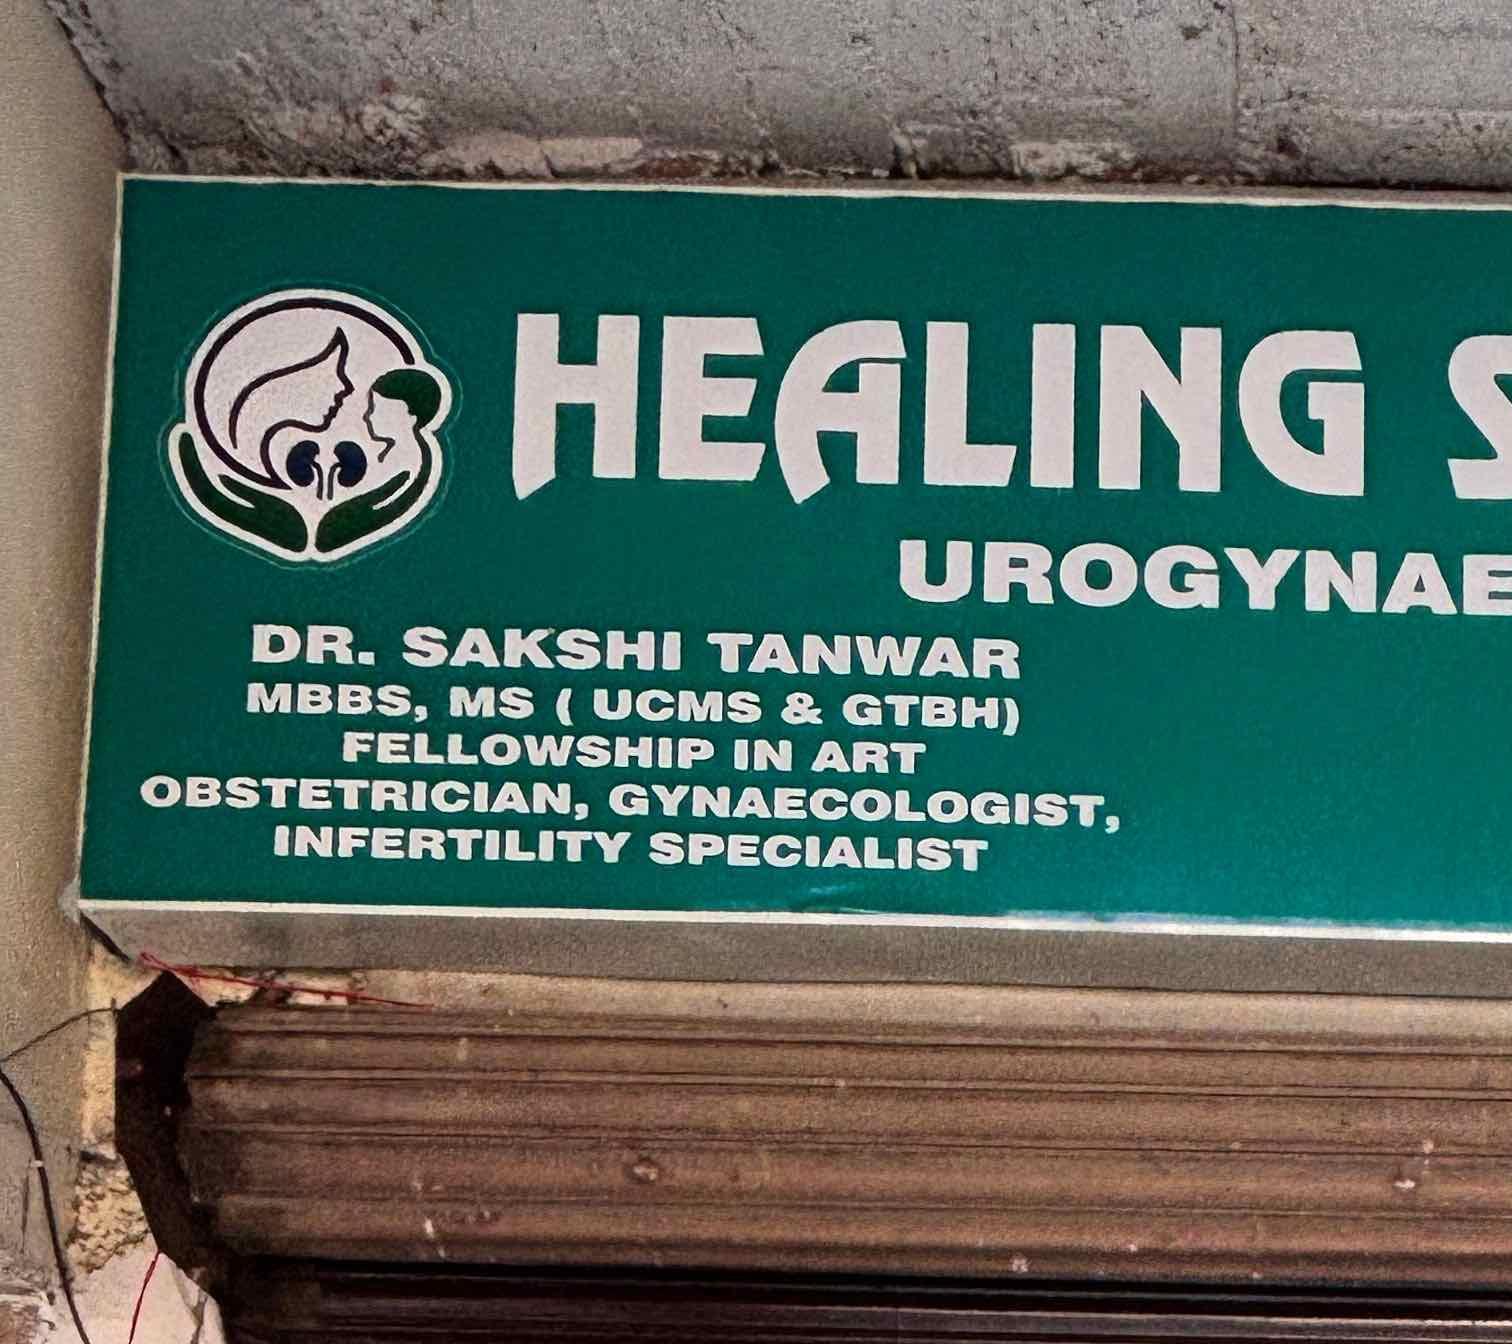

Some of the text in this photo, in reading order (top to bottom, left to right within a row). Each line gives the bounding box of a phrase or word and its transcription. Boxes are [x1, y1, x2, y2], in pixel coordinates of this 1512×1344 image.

[512, 313, 1365, 505] HEALING
[252, 623, 1020, 679] DR. SAKSHI TANWAR
[246, 682, 428, 723] MBBS,
[449, 686, 534, 719] MS
[780, 691, 823, 725] &
[842, 693, 1020, 737] GTBH)
[342, 731, 927, 774] FELLOWSHIP IN ART
[140, 775, 1120, 834] OBSTETRICIAN, GYNAECOLOGIST,
[273, 825, 989, 872] INFERTILITY SPECIALIST
